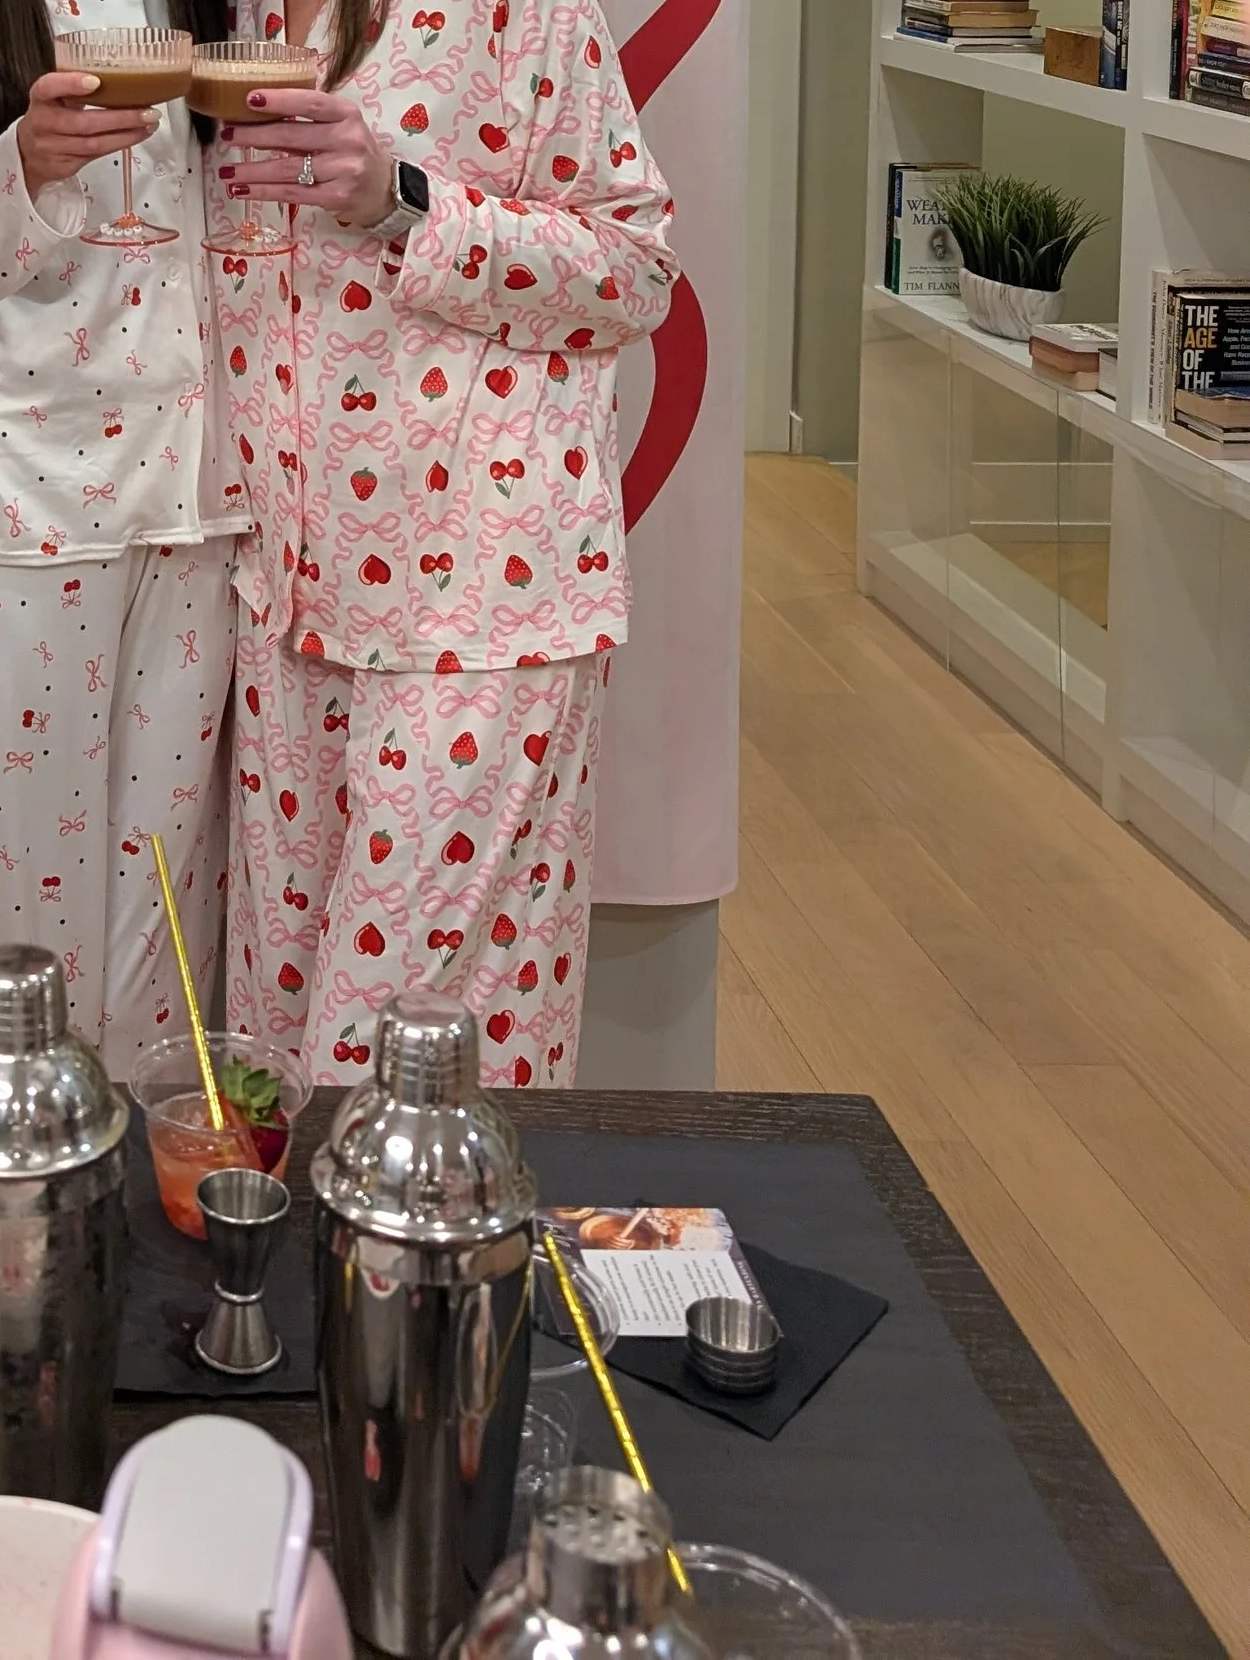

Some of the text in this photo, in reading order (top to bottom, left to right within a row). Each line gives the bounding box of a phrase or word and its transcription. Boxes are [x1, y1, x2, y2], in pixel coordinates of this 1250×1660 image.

[904, 282, 923, 291] TIM
[1184, 305, 1219, 327] THE
[1183, 327, 1218, 349] AGE
[1182, 348, 1205, 371] OF
[1181, 371, 1215, 390] THE
